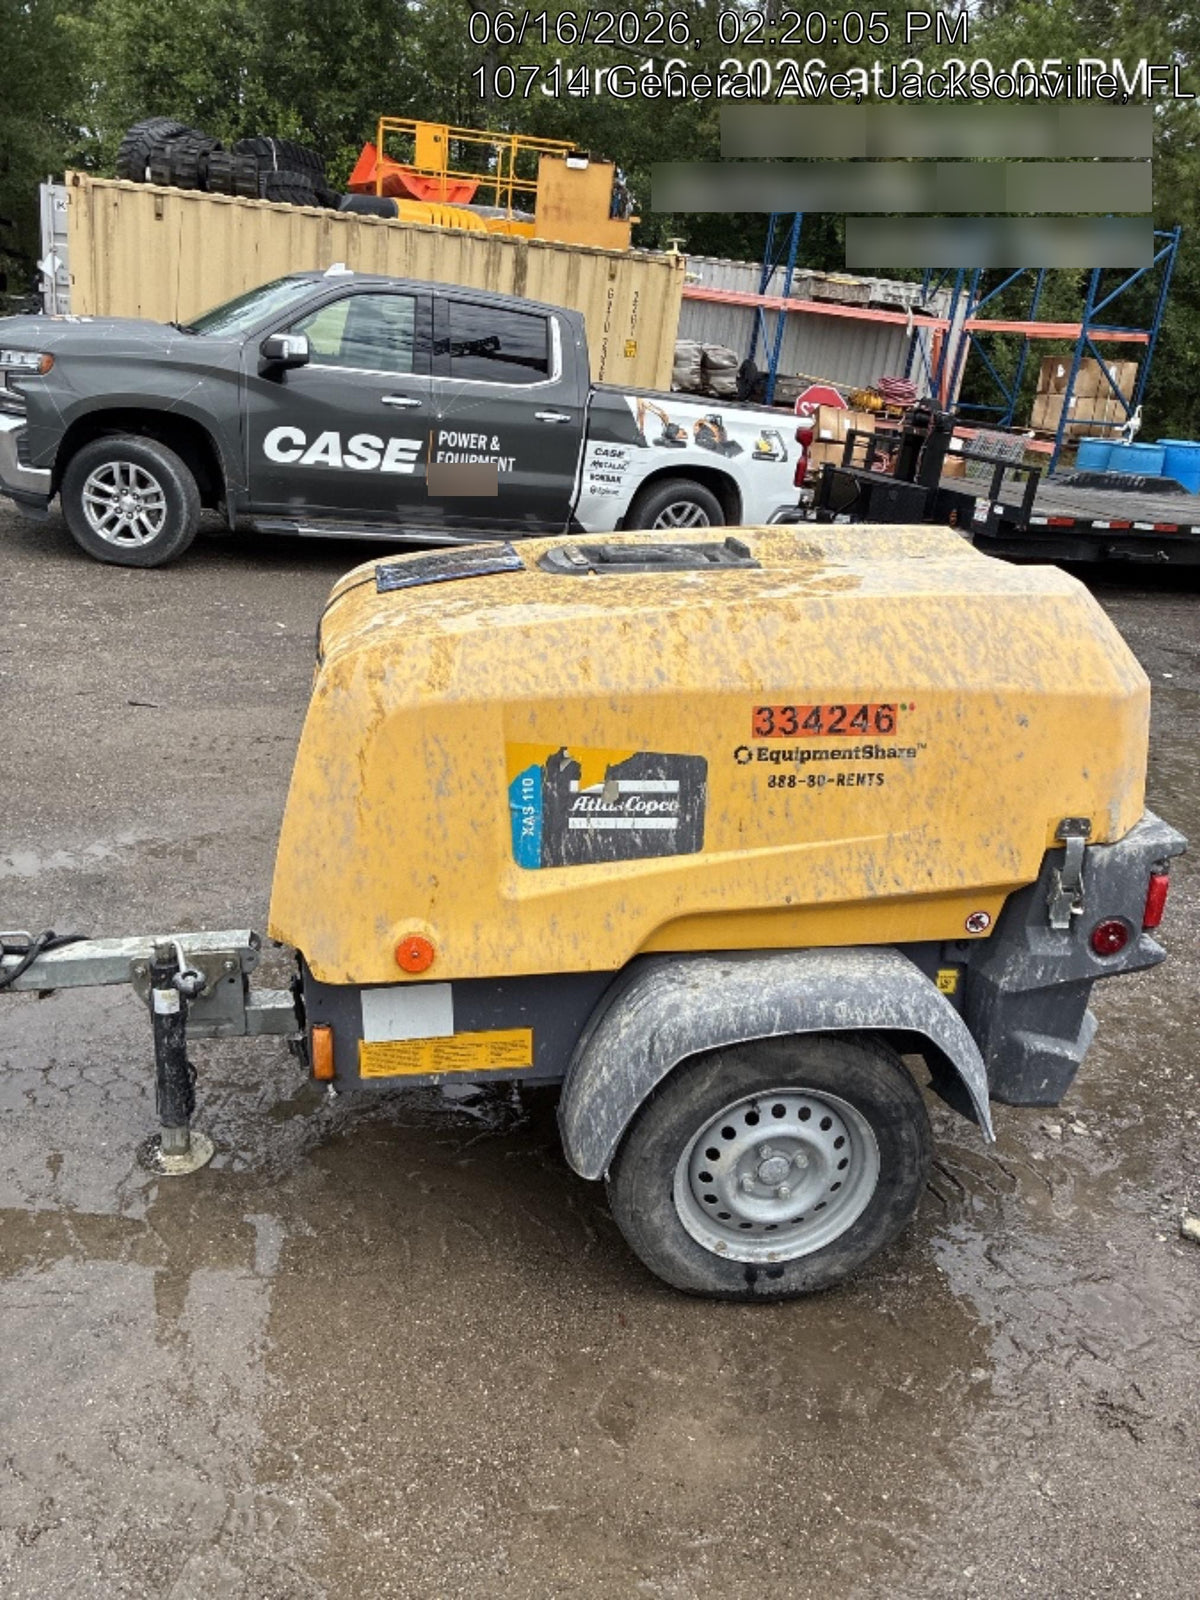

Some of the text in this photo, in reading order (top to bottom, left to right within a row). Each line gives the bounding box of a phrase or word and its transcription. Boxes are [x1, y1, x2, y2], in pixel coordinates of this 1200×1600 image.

[262, 426, 424, 474] CASE
[438, 430, 501, 451] POWER &
[594, 447, 625, 459] CASE
[755, 704, 895, 737] 334246
[767, 773, 885, 788] 888-80-RENTS
[522, 778, 535, 837] XAS 110
[625, 796, 680, 816] Copco
